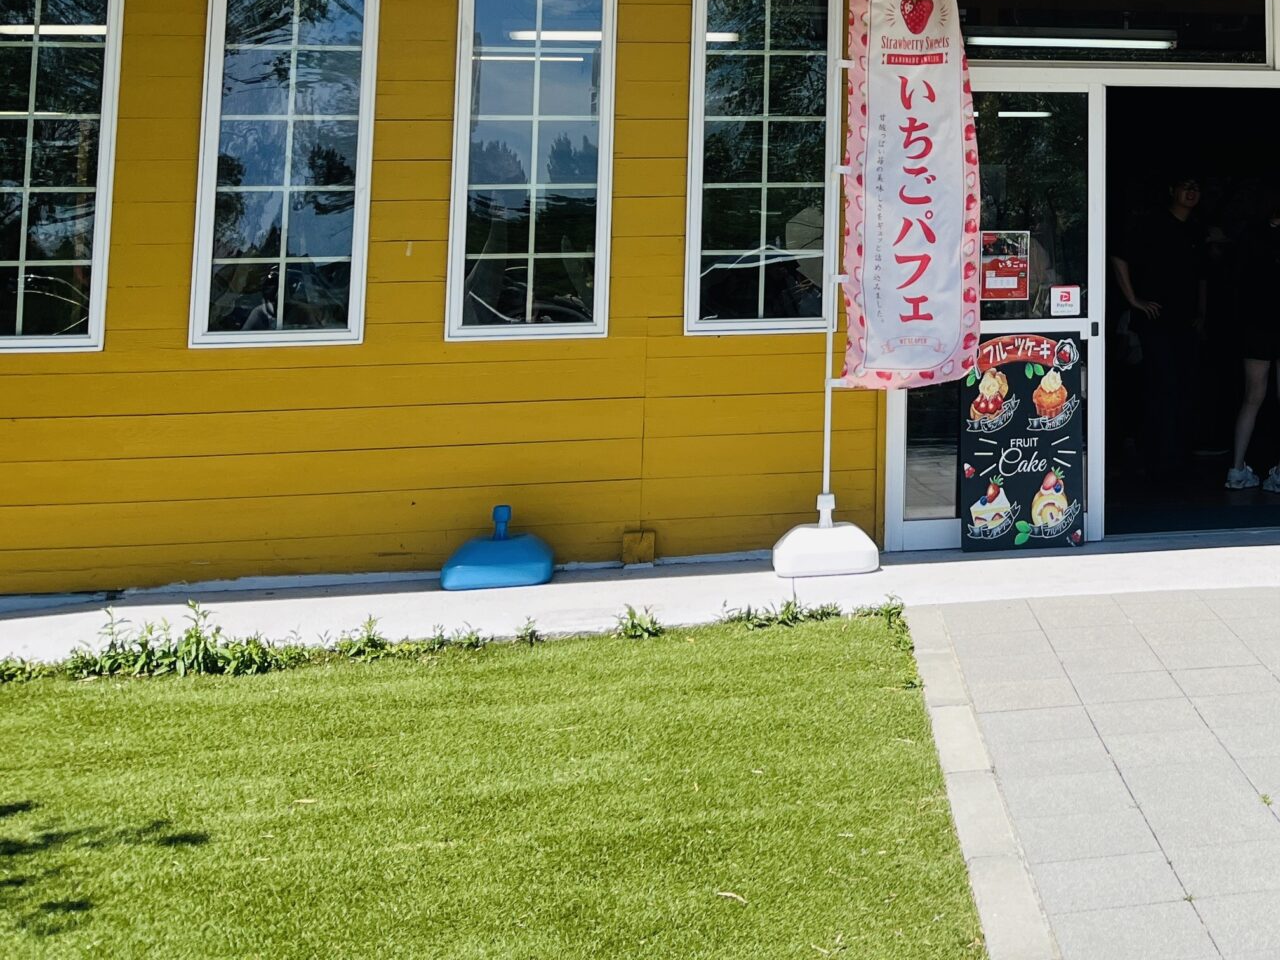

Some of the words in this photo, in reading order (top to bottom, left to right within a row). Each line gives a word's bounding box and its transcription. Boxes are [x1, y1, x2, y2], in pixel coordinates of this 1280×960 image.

[893, 74, 938, 323] いちごパフェ
[983, 337, 1051, 365] フルーツケーキ
[1010, 437, 1039, 448] FRUIT
[998, 447, 1048, 477] Cake
